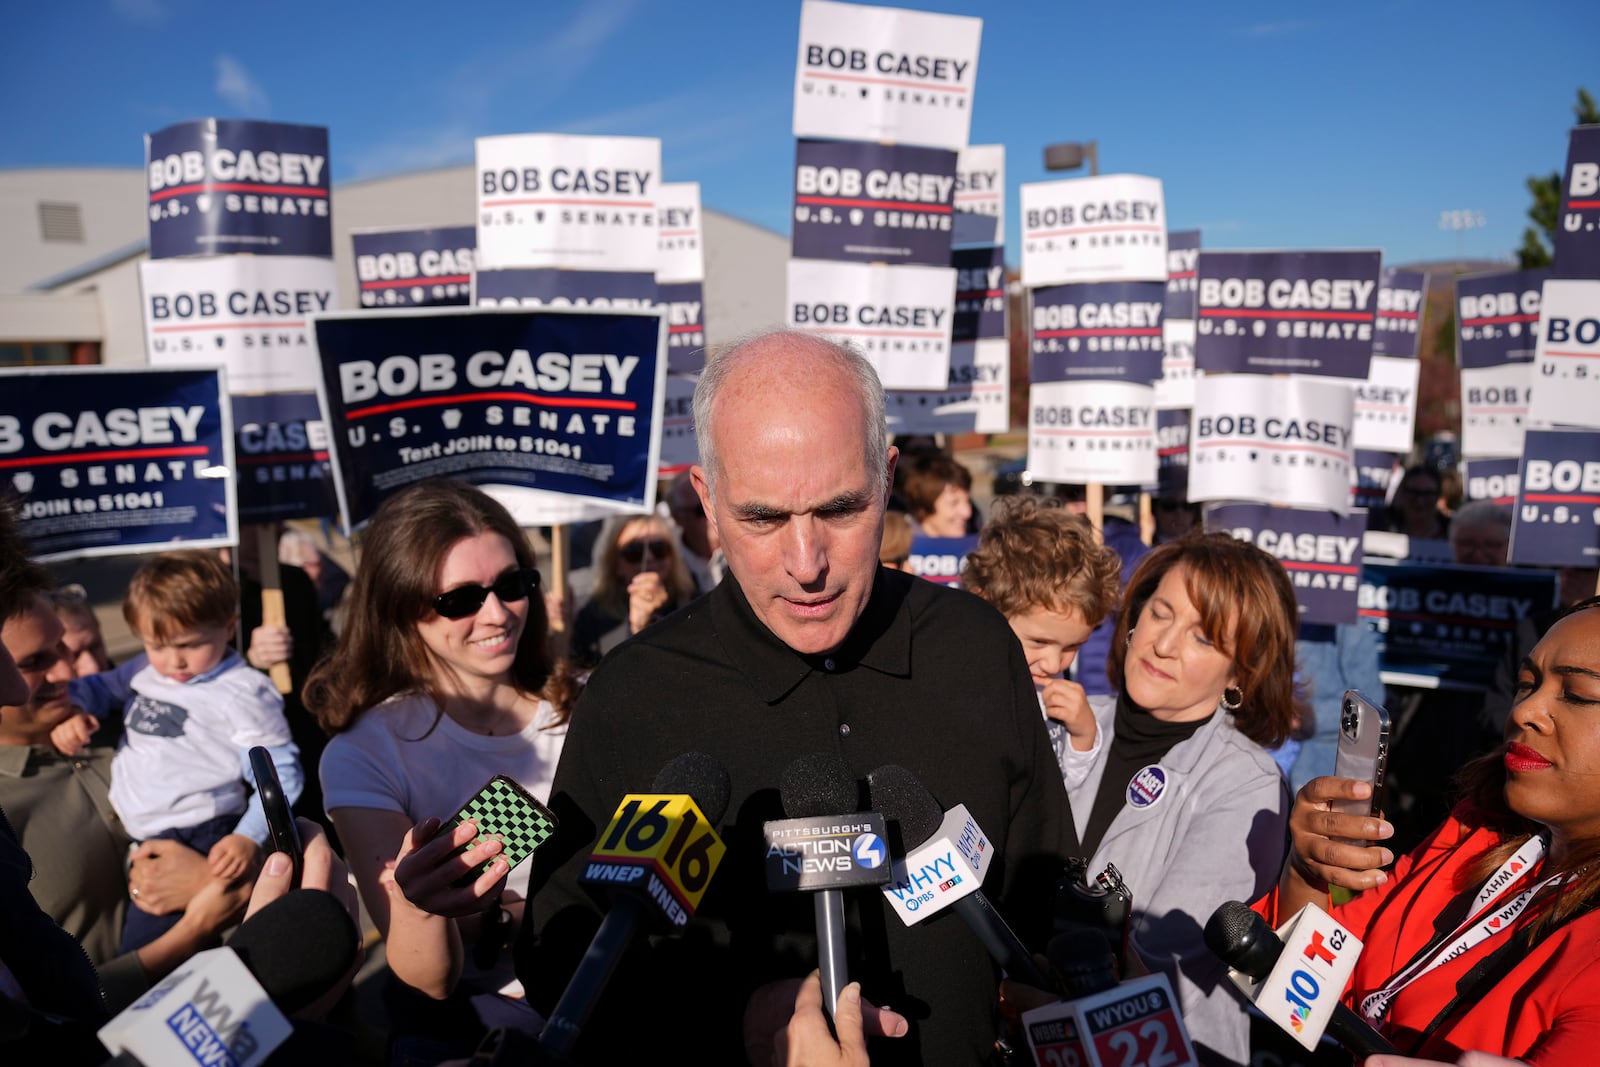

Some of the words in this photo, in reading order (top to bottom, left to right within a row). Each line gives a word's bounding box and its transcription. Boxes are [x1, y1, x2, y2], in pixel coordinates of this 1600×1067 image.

[806, 45, 867, 71] BOB
[876, 52, 968, 81] CASEY
[884, 89, 966, 109] SENATE
[150, 150, 205, 190] BOB
[211, 149, 325, 185] CASEY
[482, 168, 540, 195] BOB
[551, 167, 653, 195] CASEY
[955, 170, 998, 191] SEY
[796, 166, 862, 196] BOB
[865, 170, 953, 203] CASEY
[150, 204, 190, 221] U.S.
[225, 195, 328, 216] SENATE
[482, 211, 524, 226] U.S.
[561, 210, 655, 228] SENATE
[795, 206, 842, 224] U.S.
[873, 210, 952, 231] SENATE
[1027, 205, 1075, 229] BOB
[1081, 201, 1159, 223] CASEY
[1089, 234, 1161, 248] SENATE
[358, 252, 418, 281] BOB
[419, 249, 473, 277] CAS
[151, 293, 217, 320] BOB
[228, 291, 331, 316] CASEY
[362, 288, 406, 305] U.S.
[1200, 278, 1265, 308] BOB
[1267, 278, 1376, 309] CASEY
[1377, 287, 1422, 312] SEY
[1459, 293, 1518, 319] BOB
[794, 303, 848, 323] BOB
[858, 305, 945, 327] CASEY
[1033, 304, 1077, 329] BOB
[1079, 302, 1162, 328] CASEY
[154, 338, 203, 351] U.S.
[243, 333, 308, 348] SENA
[1198, 319, 1246, 335] U.S.
[1276, 321, 1372, 340] SENATE
[1547, 318, 1600, 345] BO
[866, 340, 944, 353] SENATE
[1087, 336, 1163, 351] SENATE
[339, 353, 457, 403] BOB
[465, 349, 640, 395] CASEY
[1355, 387, 1410, 404] ASEY
[1468, 387, 1518, 404] BOB
[33, 406, 204, 450] CASEY
[348, 417, 422, 447] U.S.
[486, 405, 636, 436] SENATE
[1034, 406, 1073, 426] BOB
[1079, 406, 1151, 427] CASEY
[240, 420, 330, 452] CASE
[1087, 438, 1152, 450] SENATE
[1198, 416, 1256, 437] BOB
[1264, 419, 1351, 448] CASEY
[399, 444, 442, 464] Text
[443, 434, 492, 455] JOIN
[495, 436, 518, 450] to
[519, 436, 582, 460] 51041
[60, 459, 210, 488] SENATE
[256, 463, 322, 482] SENA
[1273, 456, 1350, 476] SENATE
[22, 498, 69, 520] JOIN
[73, 497, 97, 512] to
[98, 490, 164, 511] 51041
[1521, 505, 1580, 524] U.S.
[1257, 529, 1360, 564] CASEY
[1292, 571, 1358, 591] NATE
[1357, 583, 1421, 612] BOB
[1426, 590, 1532, 620] CASEY
[1436, 623, 1513, 643] SENAT
[1136, 768, 1164, 795] CASEY
[602, 800, 671, 852] 16
[772, 823, 872, 838] PITTSBURGH'S
[957, 816, 980, 858] WHYY
[663, 808, 717, 893] 16
[766, 838, 852, 859] ACTION
[856, 834, 881, 869] 4
[585, 864, 644, 882] WNEP
[783, 856, 852, 875] NEWS
[889, 851, 957, 902] WHYY
[648, 873, 688, 927] WNEP
[918, 891, 935, 904] PBS
[939, 875, 963, 892] npr
[1480, 870, 1513, 903] WHYY
[1285, 969, 1320, 1011] 10
[1330, 929, 1348, 951] 62
[1092, 995, 1150, 1029] WYOU
[1107, 1020, 1178, 1067] 22
